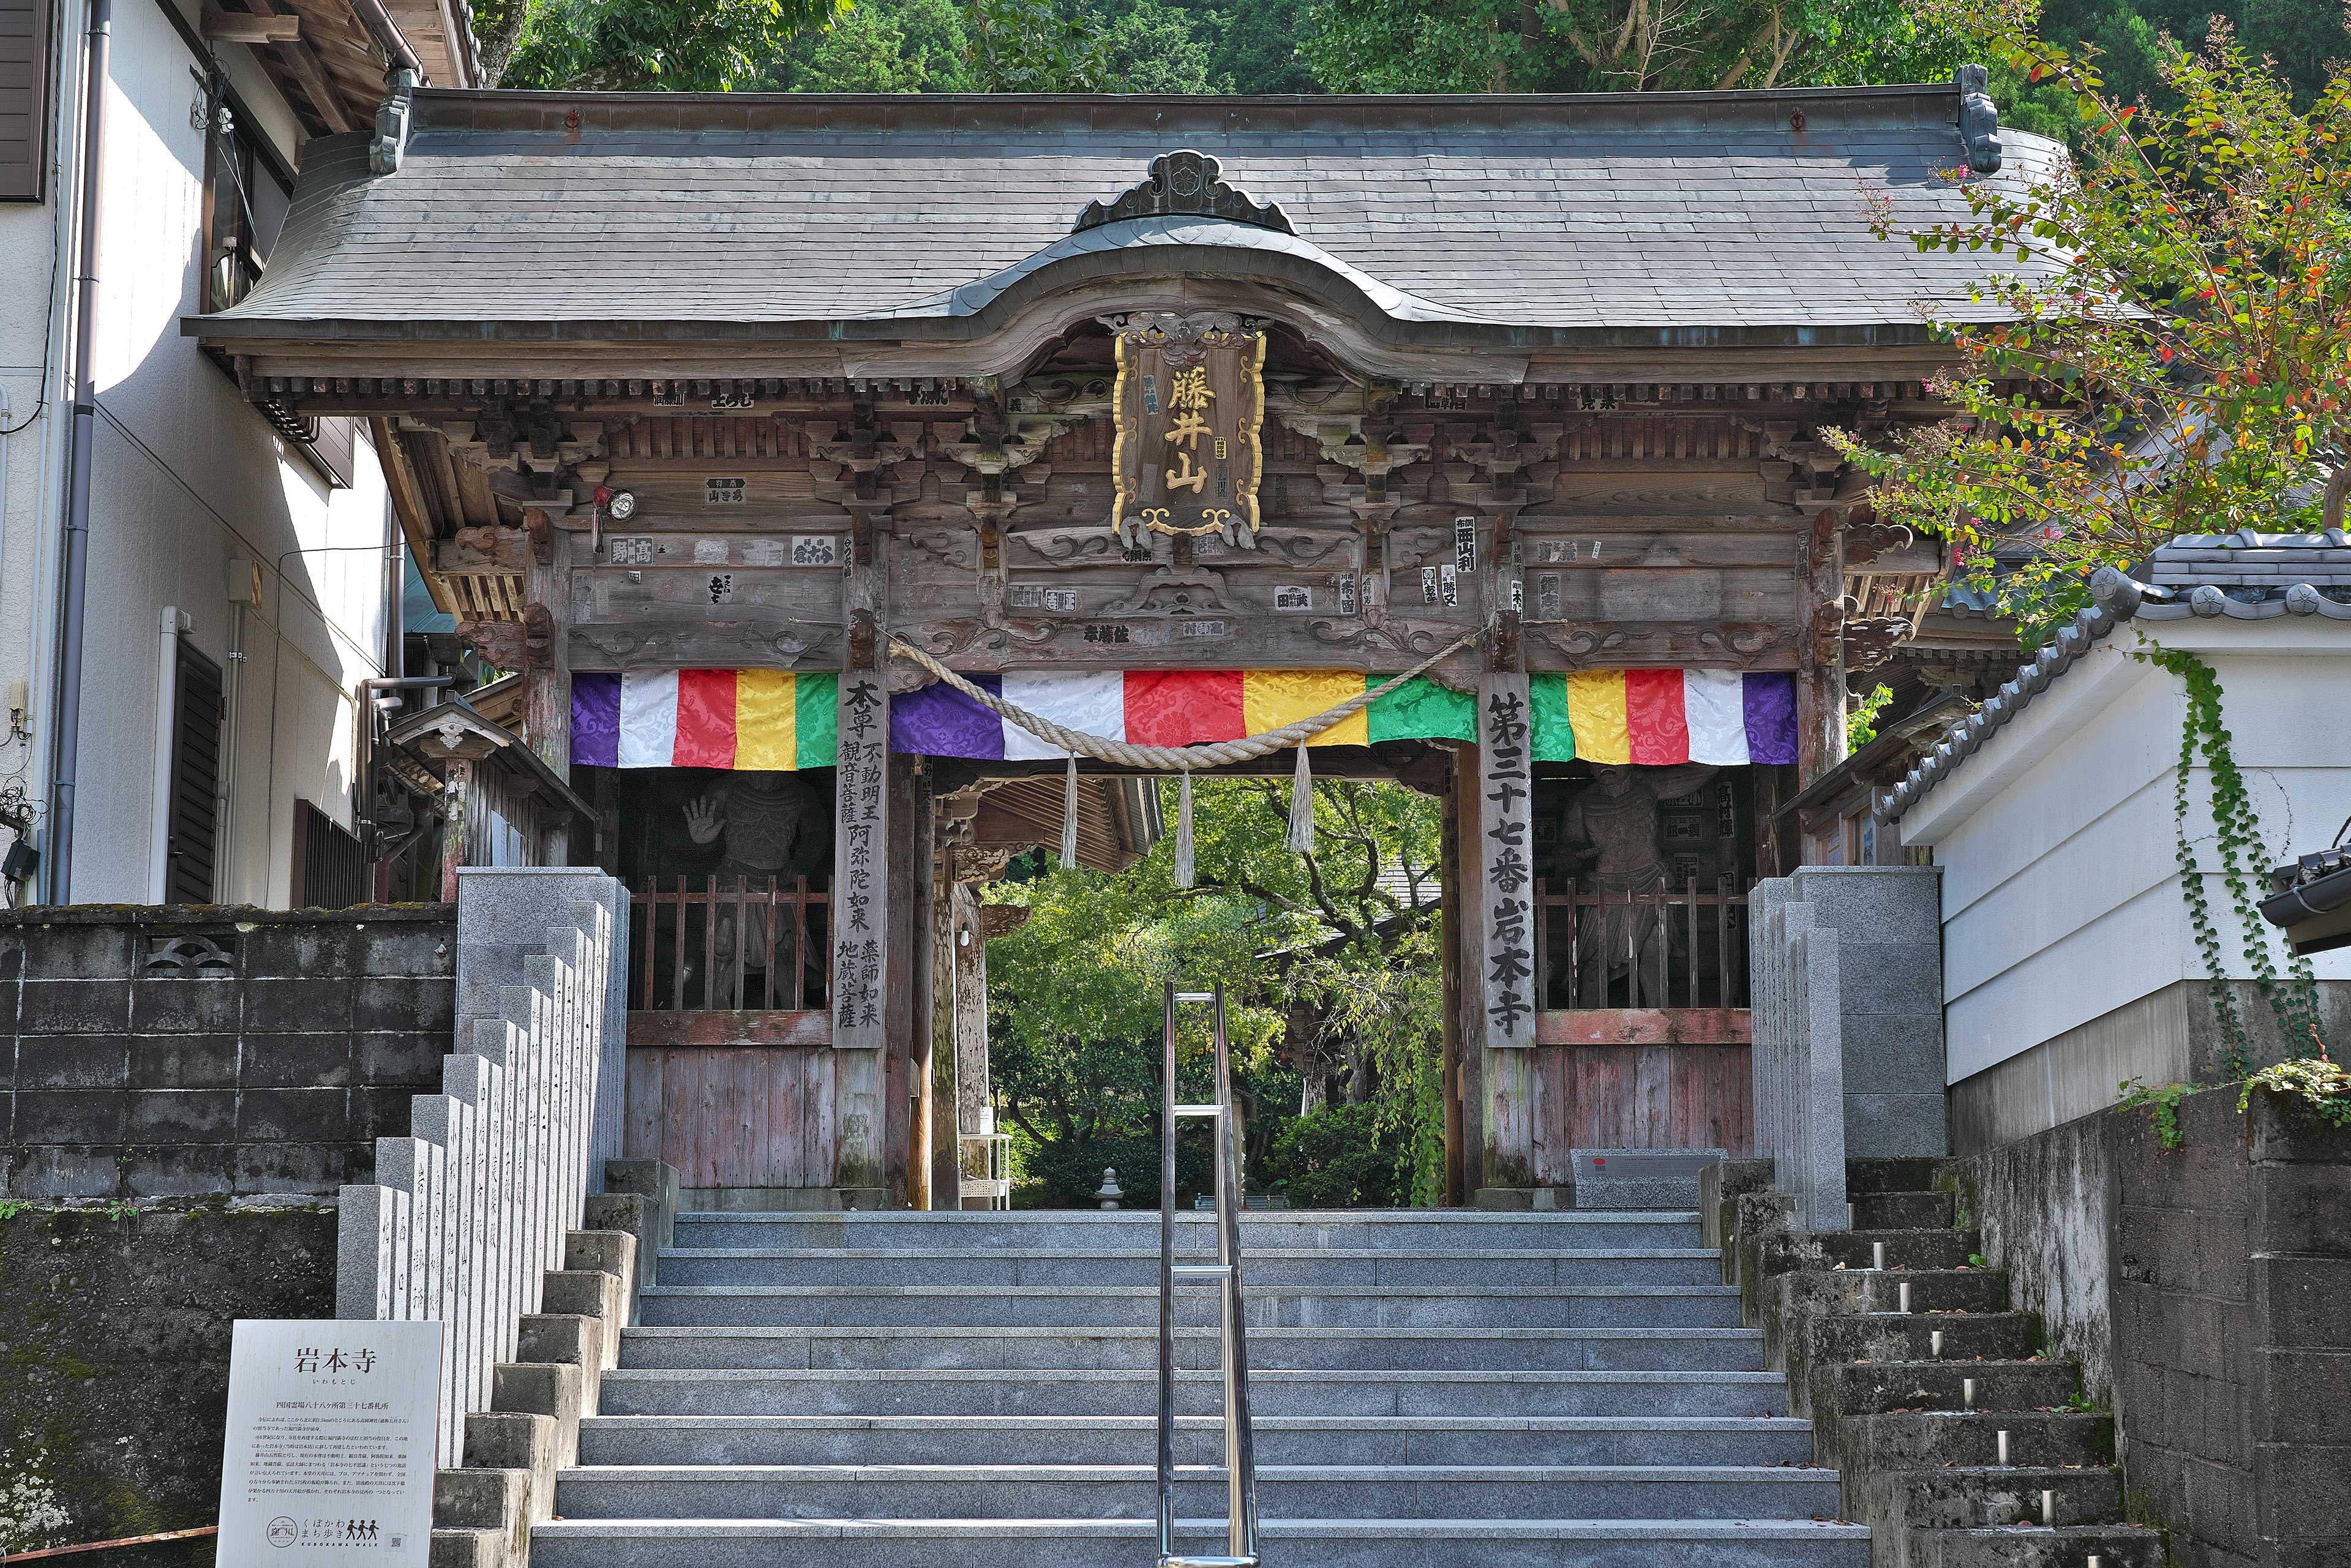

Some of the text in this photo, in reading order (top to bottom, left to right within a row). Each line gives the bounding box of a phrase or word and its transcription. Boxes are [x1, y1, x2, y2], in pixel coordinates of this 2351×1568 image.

[1457, 528, 1475, 571] 西山利
[1278, 593, 1308, 608] 武田
[1443, 582, 1456, 606] 勝又
[838, 741, 861, 824] 観音菩薩
[860, 742, 882, 821] 不動明王
[847, 823, 872, 933] 阿弥陀如来
[1487, 692, 1532, 1037] 第三十七番岩本寺
[836, 940, 858, 1029] 地蔵菩薩
[859, 940, 880, 1029] 薬師如来
[293, 1347, 377, 1374] 岩本寺
[301, 1529, 343, 1539] まち歩き
[303, 1518, 345, 1529] くぼかわ
